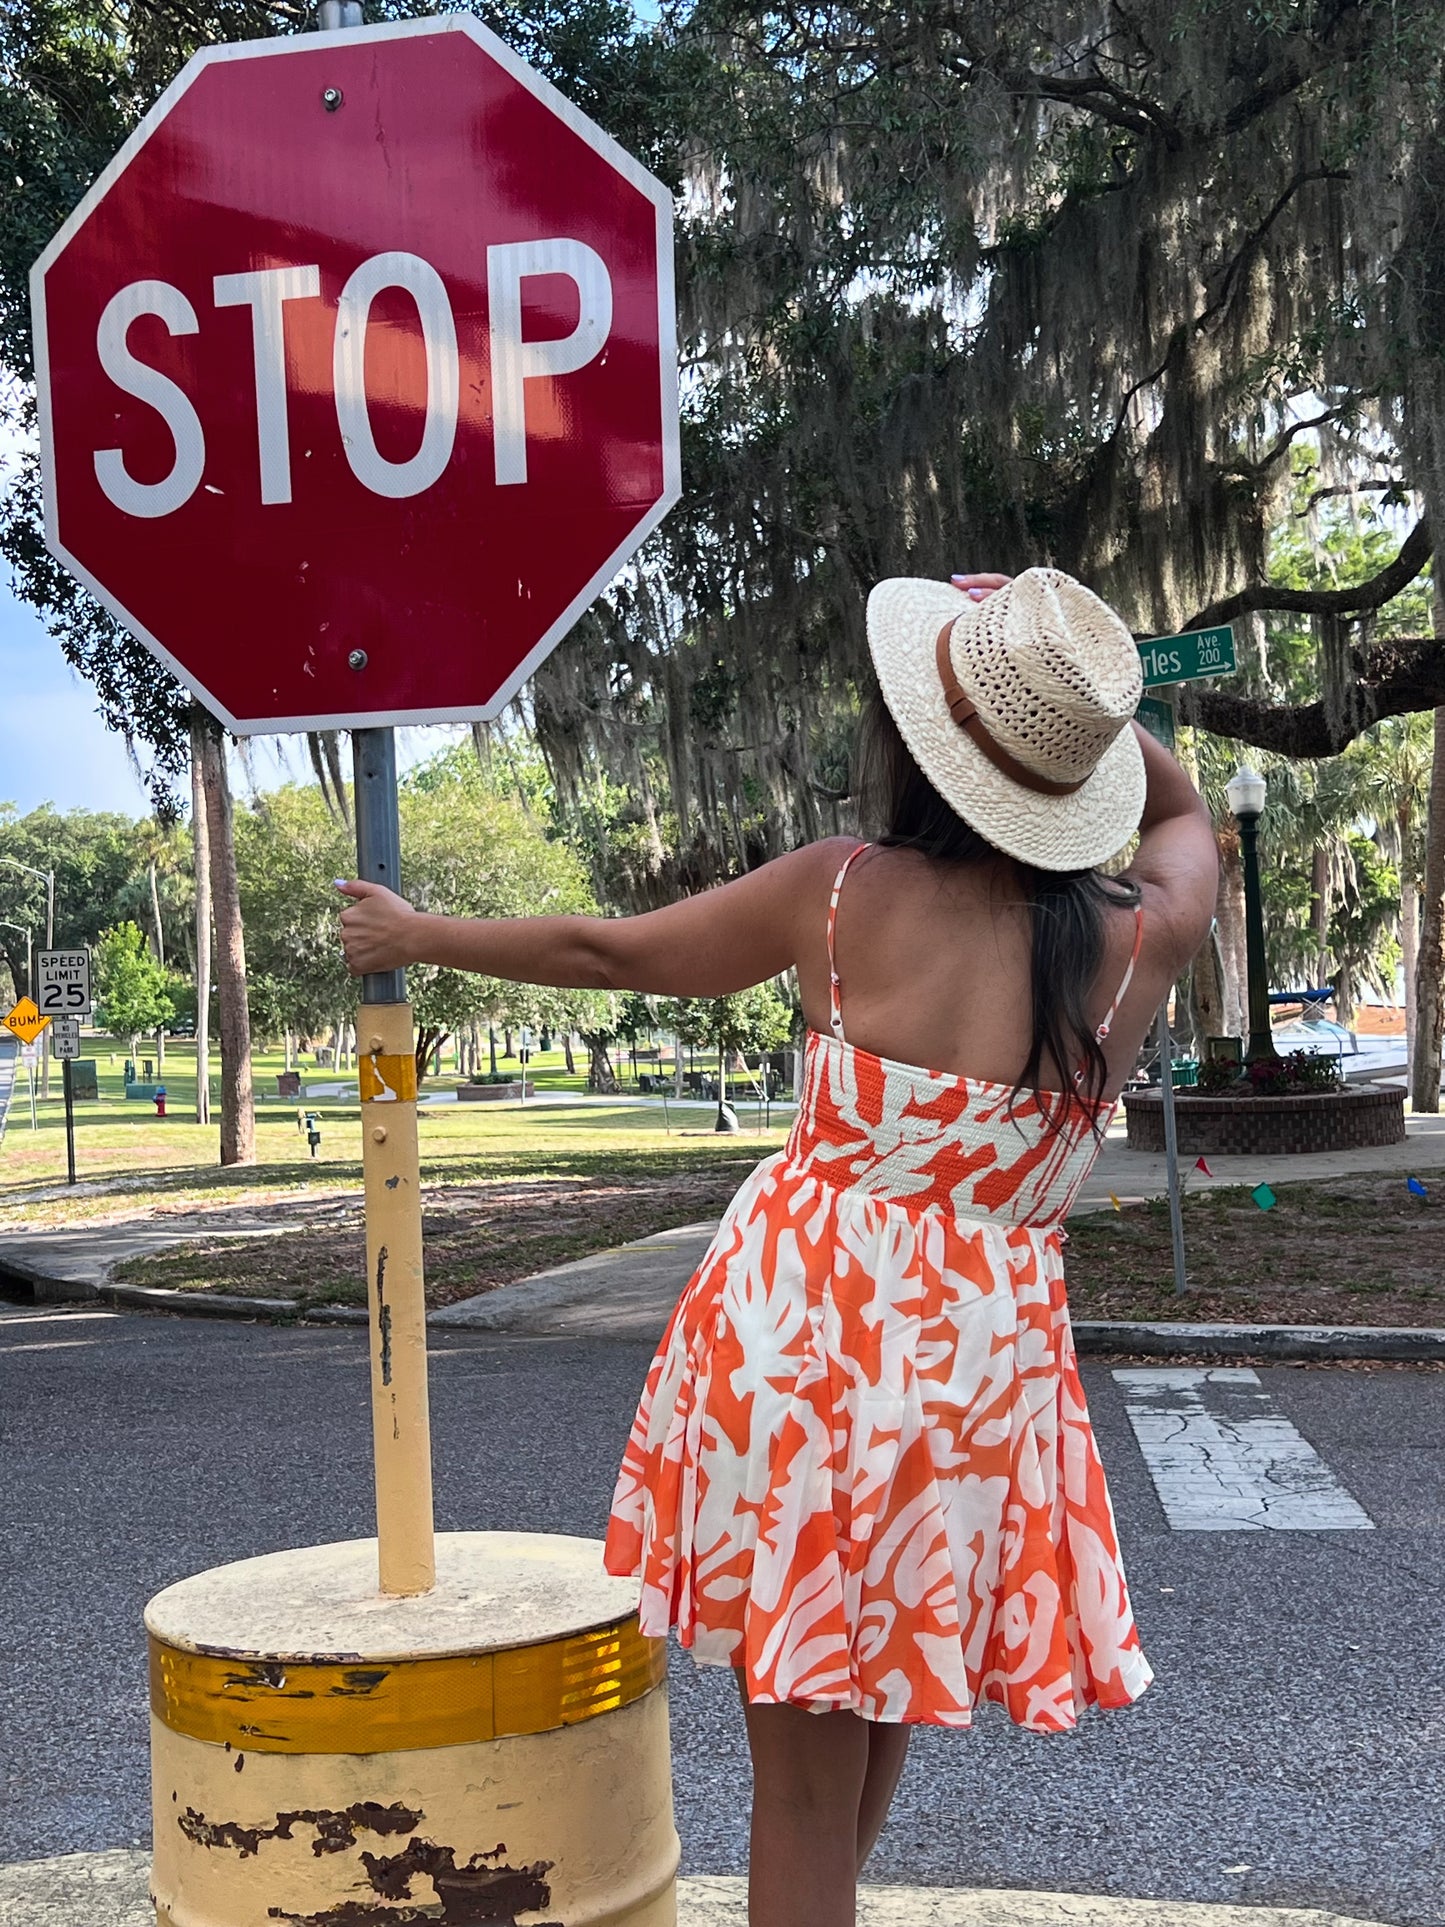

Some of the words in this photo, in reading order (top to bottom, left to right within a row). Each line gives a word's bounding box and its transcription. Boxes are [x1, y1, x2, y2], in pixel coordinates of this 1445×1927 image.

[93, 237, 614, 519] STOP
[1198, 648, 1220, 665] 200
[41, 957, 85, 968] SPEED
[46, 970, 80, 981] LIMIT
[44, 983, 85, 1008] 25
[9, 1015, 45, 1027] BUMP
